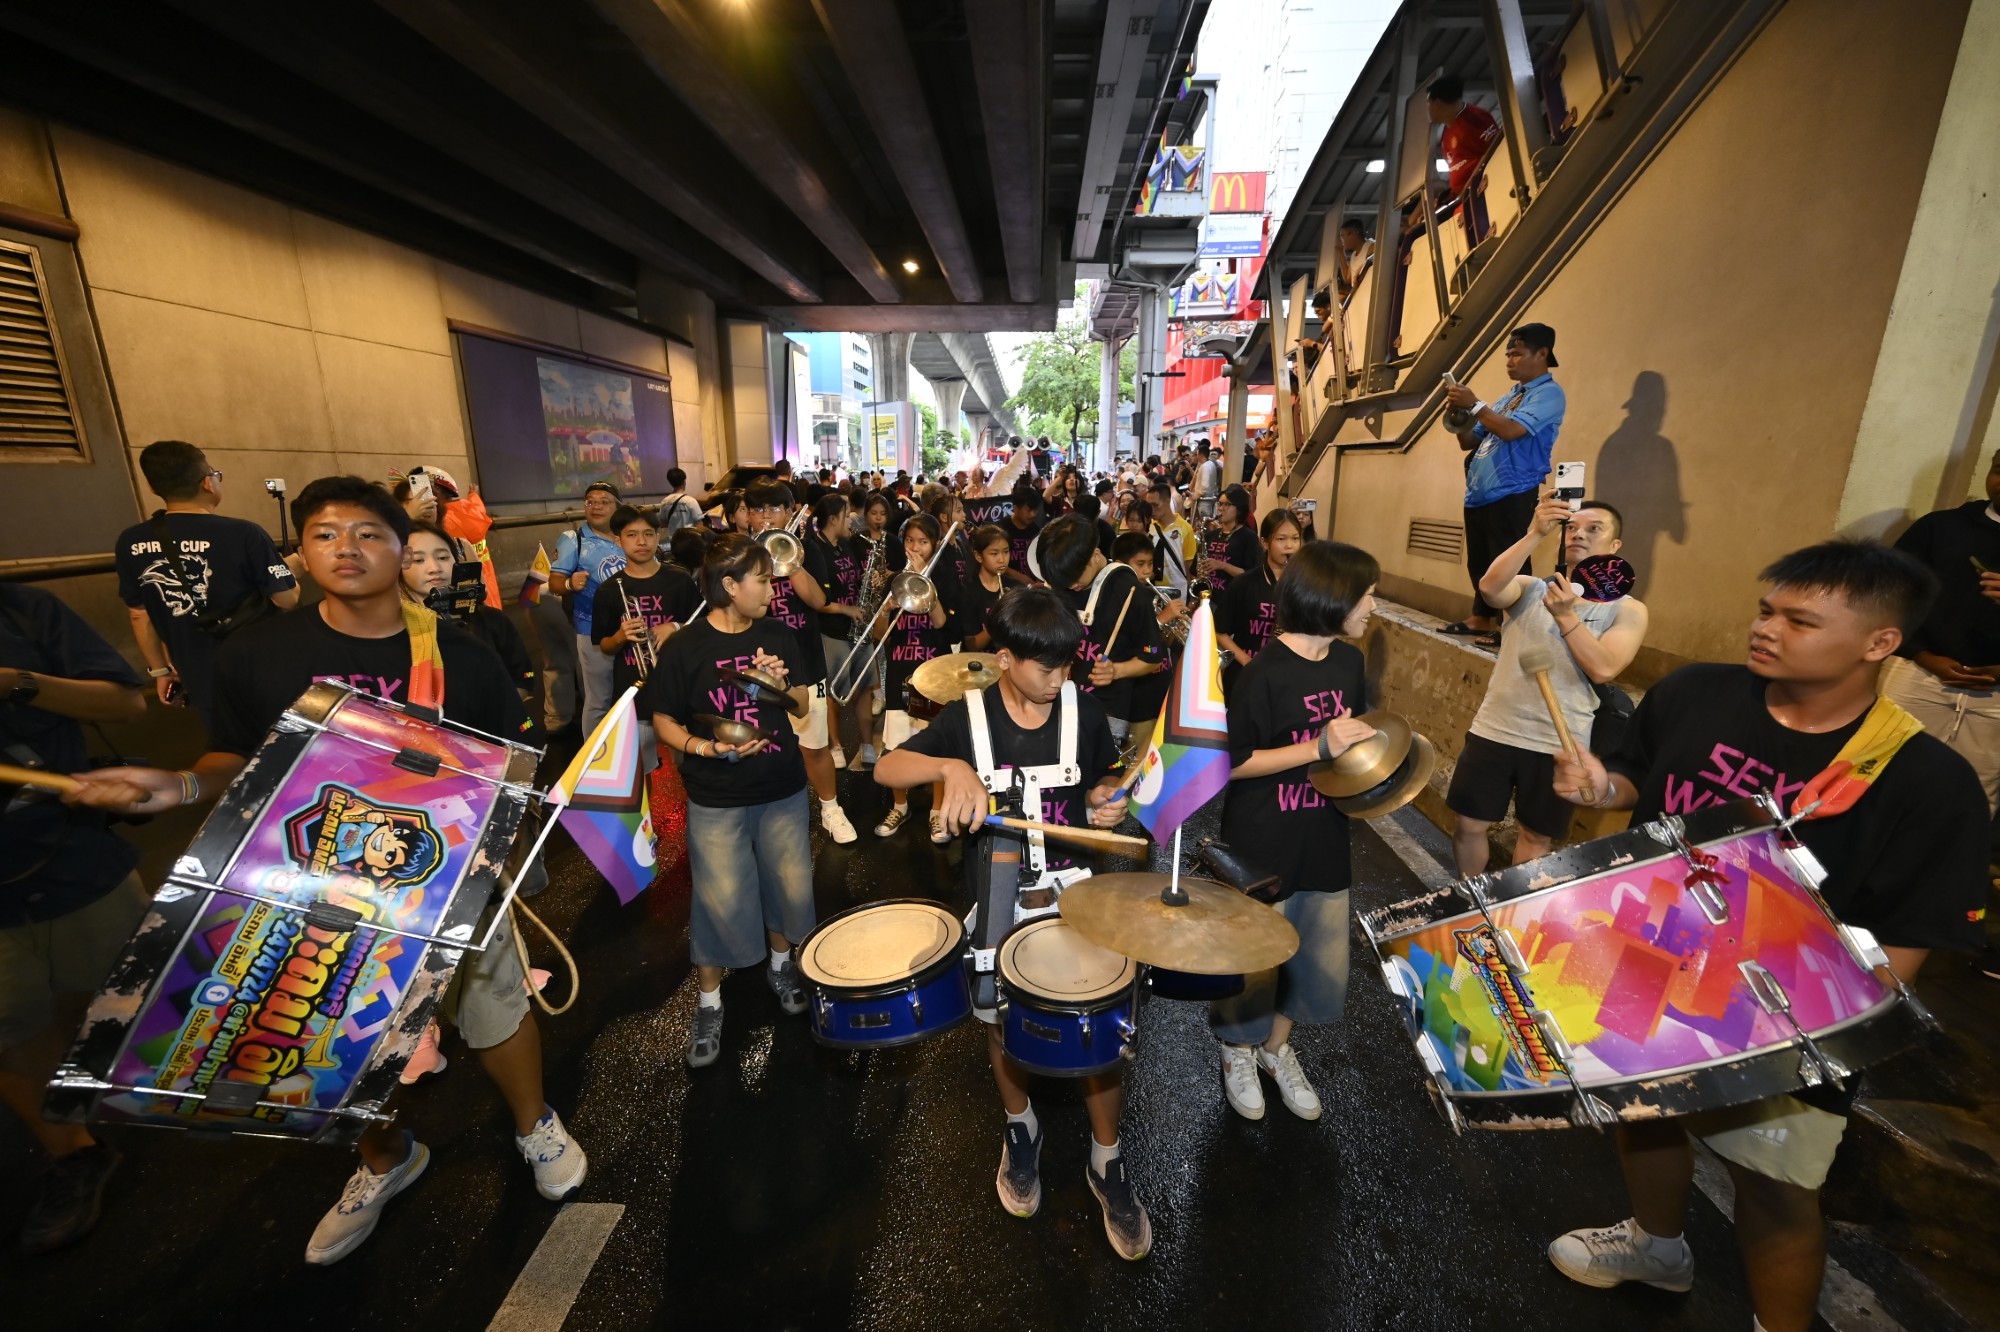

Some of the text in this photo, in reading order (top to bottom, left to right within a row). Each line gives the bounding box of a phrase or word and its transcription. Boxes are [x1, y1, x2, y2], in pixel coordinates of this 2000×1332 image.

[180, 540, 211, 553] CUP
[1208, 541, 1229, 553] SEX
[1589, 563, 1620, 594] worker
[1600, 559, 1630, 586] Sex
[771, 599, 789, 616] IS
[1259, 603, 1276, 618] SE
[1249, 619, 1272, 636] WO
[907, 631, 921, 645] IS
[893, 645, 937, 662] WORK
[816, 682, 826, 699] R
[1303, 689, 1346, 723] SEX
[1698, 742, 1806, 814] SEX
[1278, 783, 1326, 812] WO
[222, 944, 248, 977] อินดี้
[185, 1007, 210, 1040] ประถม
